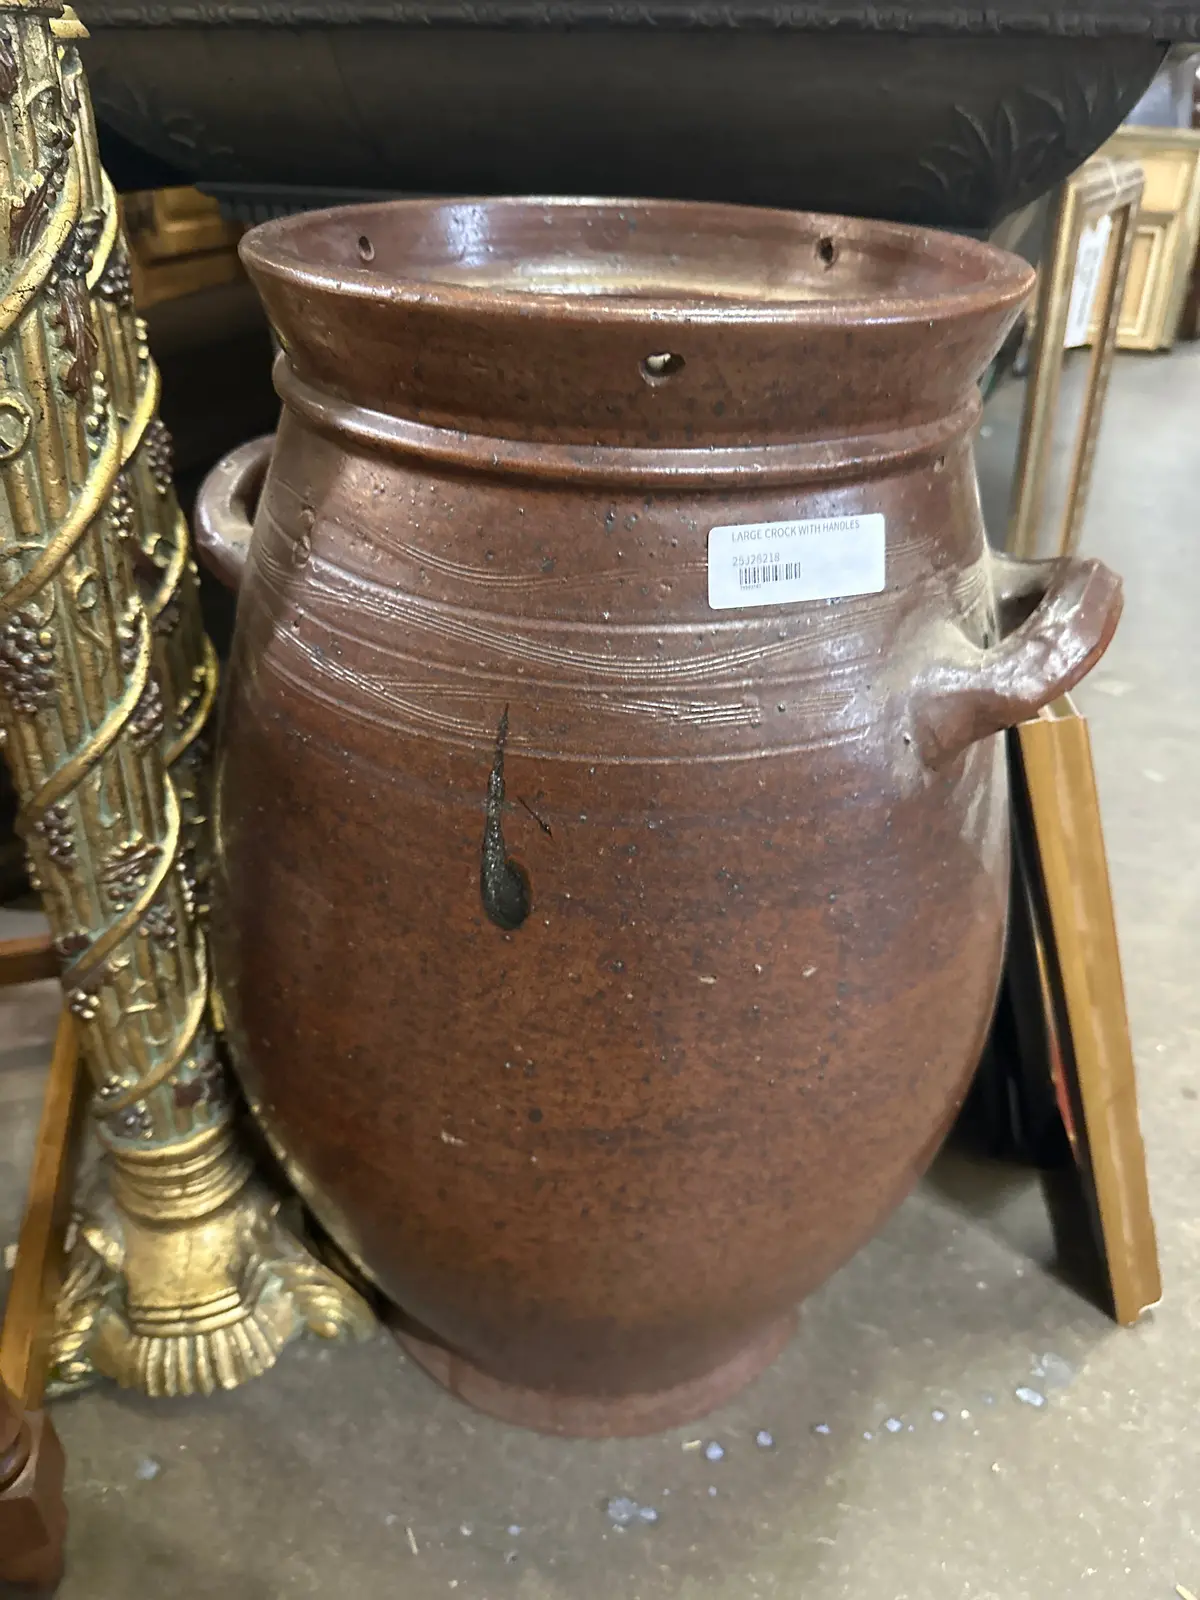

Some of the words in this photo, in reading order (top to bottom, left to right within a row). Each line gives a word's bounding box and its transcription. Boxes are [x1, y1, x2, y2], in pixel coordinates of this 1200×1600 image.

[731, 529, 762, 542] LARGE
[764, 526, 797, 539] CROCK
[798, 523, 821, 536] WITH
[822, 519, 860, 533] HANDLES
